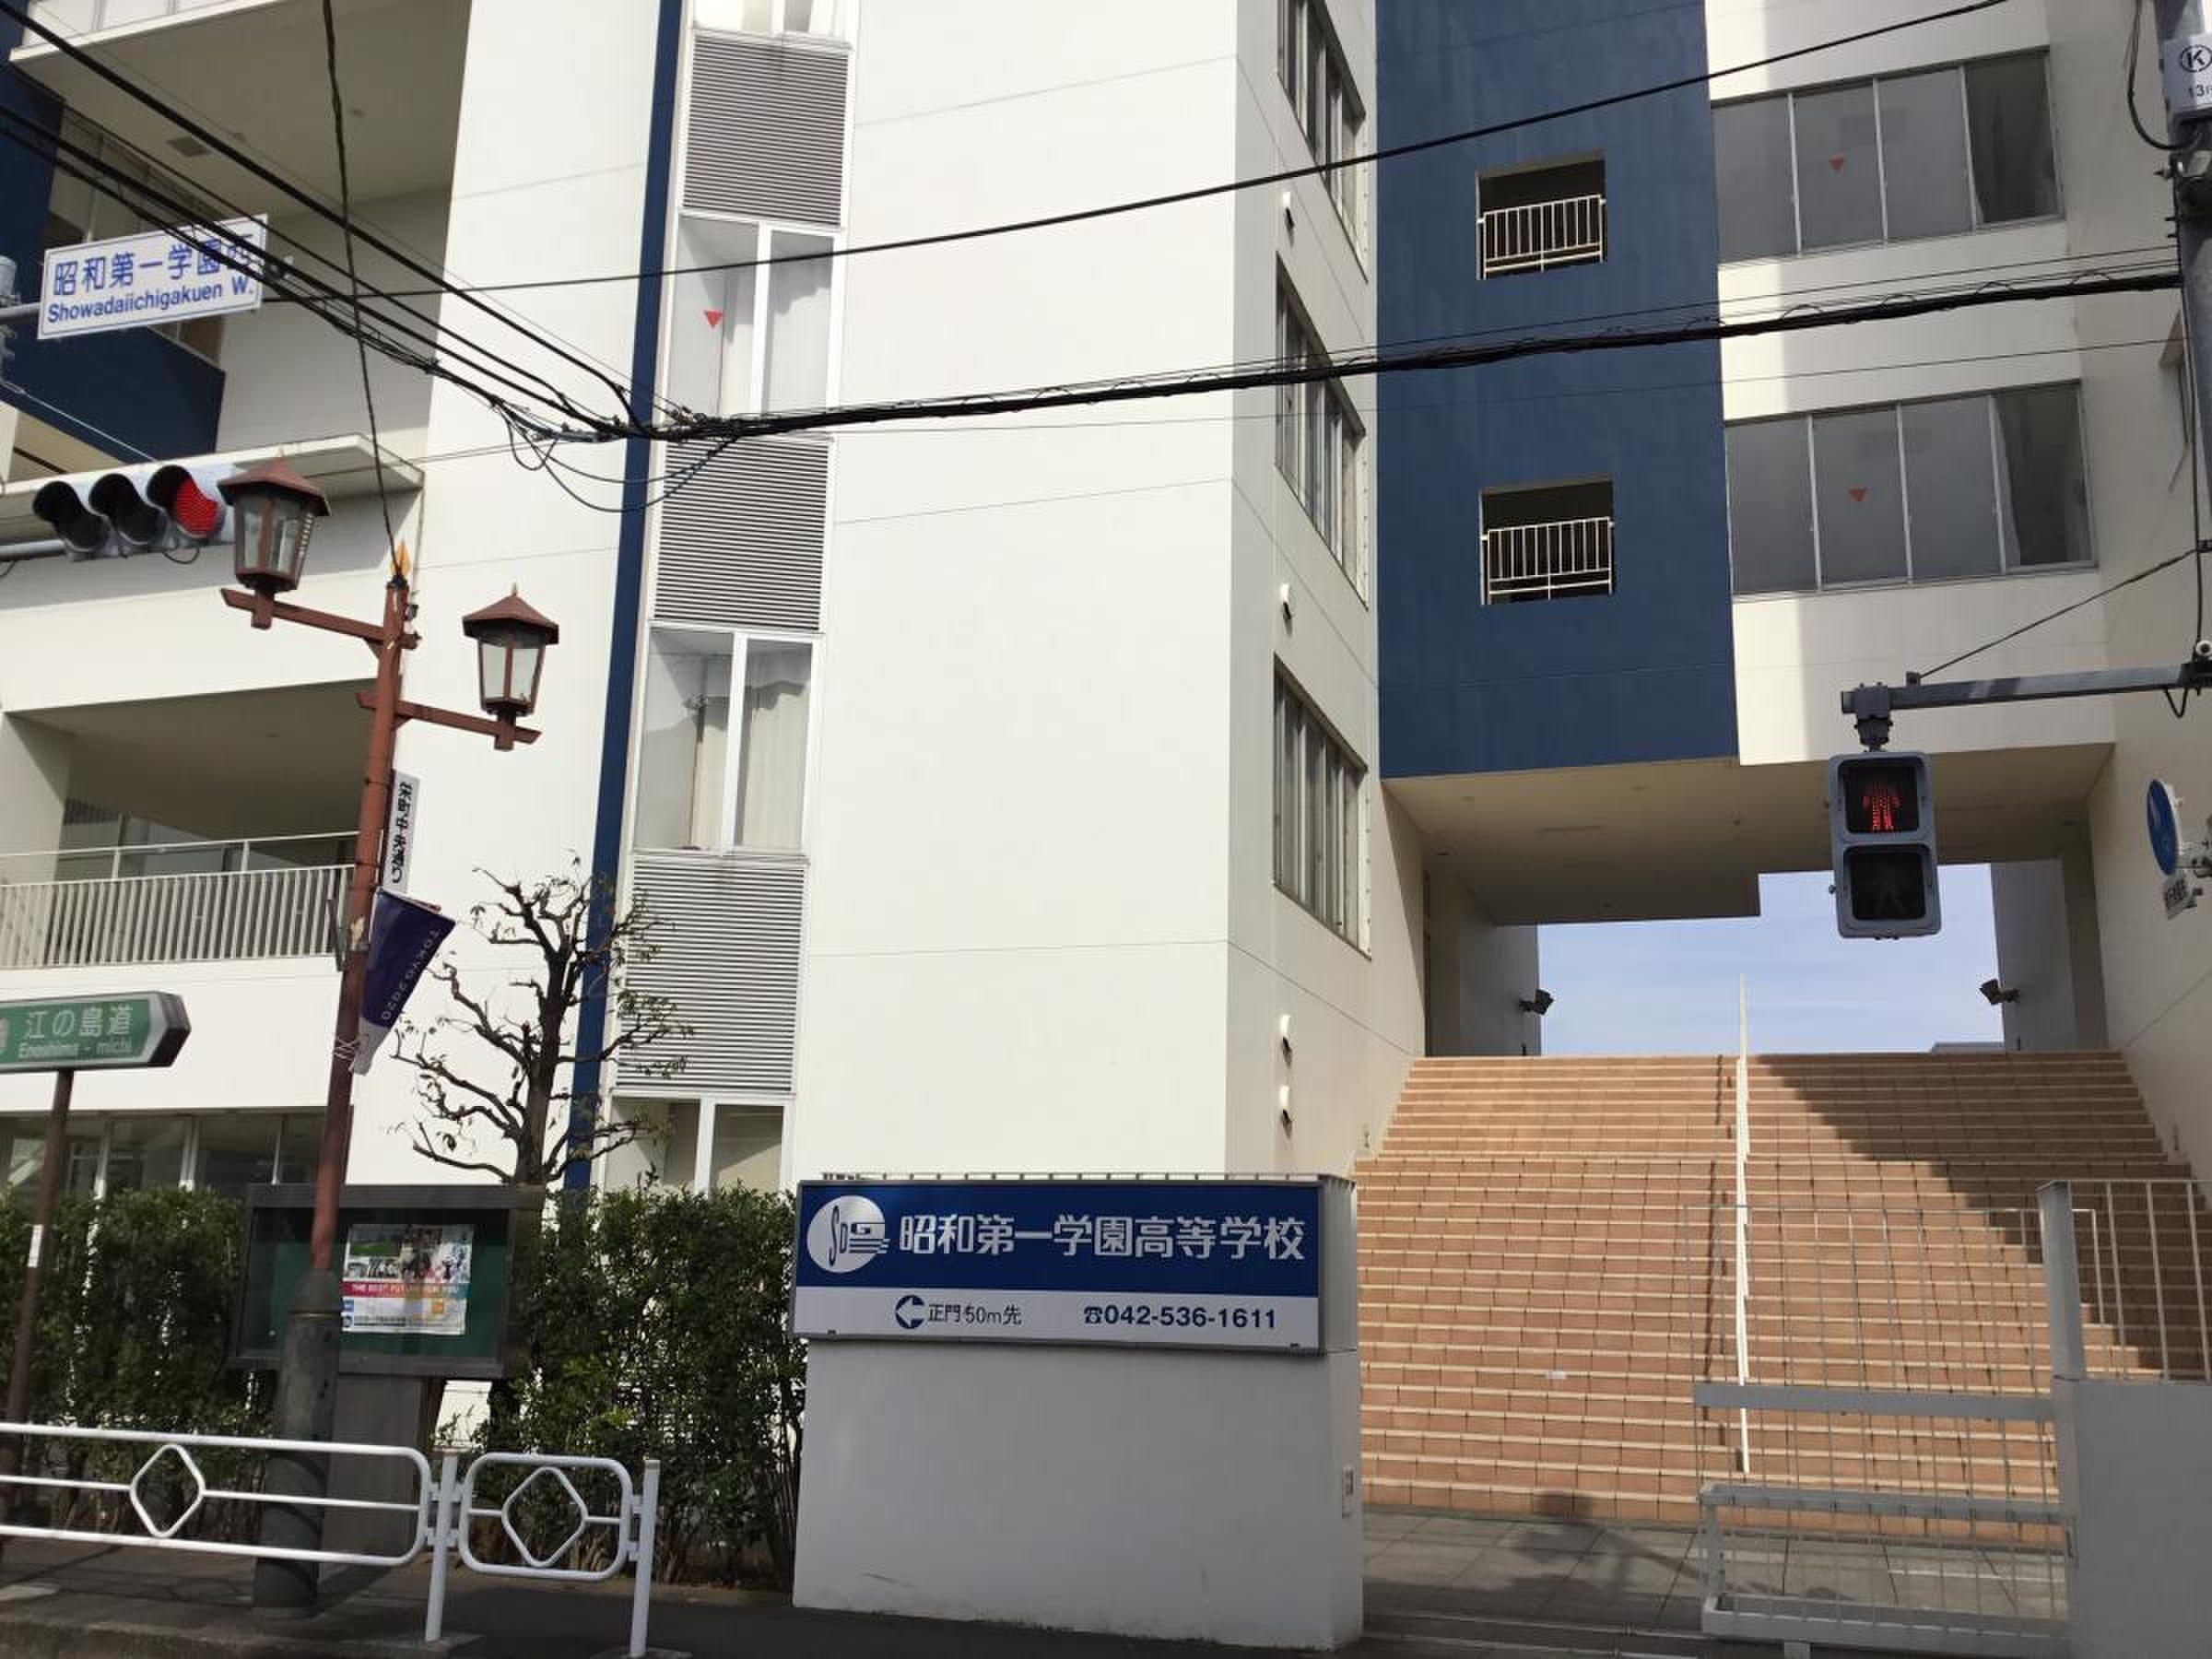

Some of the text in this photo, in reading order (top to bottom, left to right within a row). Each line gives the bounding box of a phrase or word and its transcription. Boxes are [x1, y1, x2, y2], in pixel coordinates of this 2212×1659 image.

[48, 283, 222, 323] Showadaiichigakuen
[23, 1003, 133, 1040] 江の島道
[900, 1214, 1305, 1261] 昭和第一学園高等学校
[928, 1303, 1022, 1326] 正門50m先
[1105, 1305, 1277, 1329] 042-536-1611
